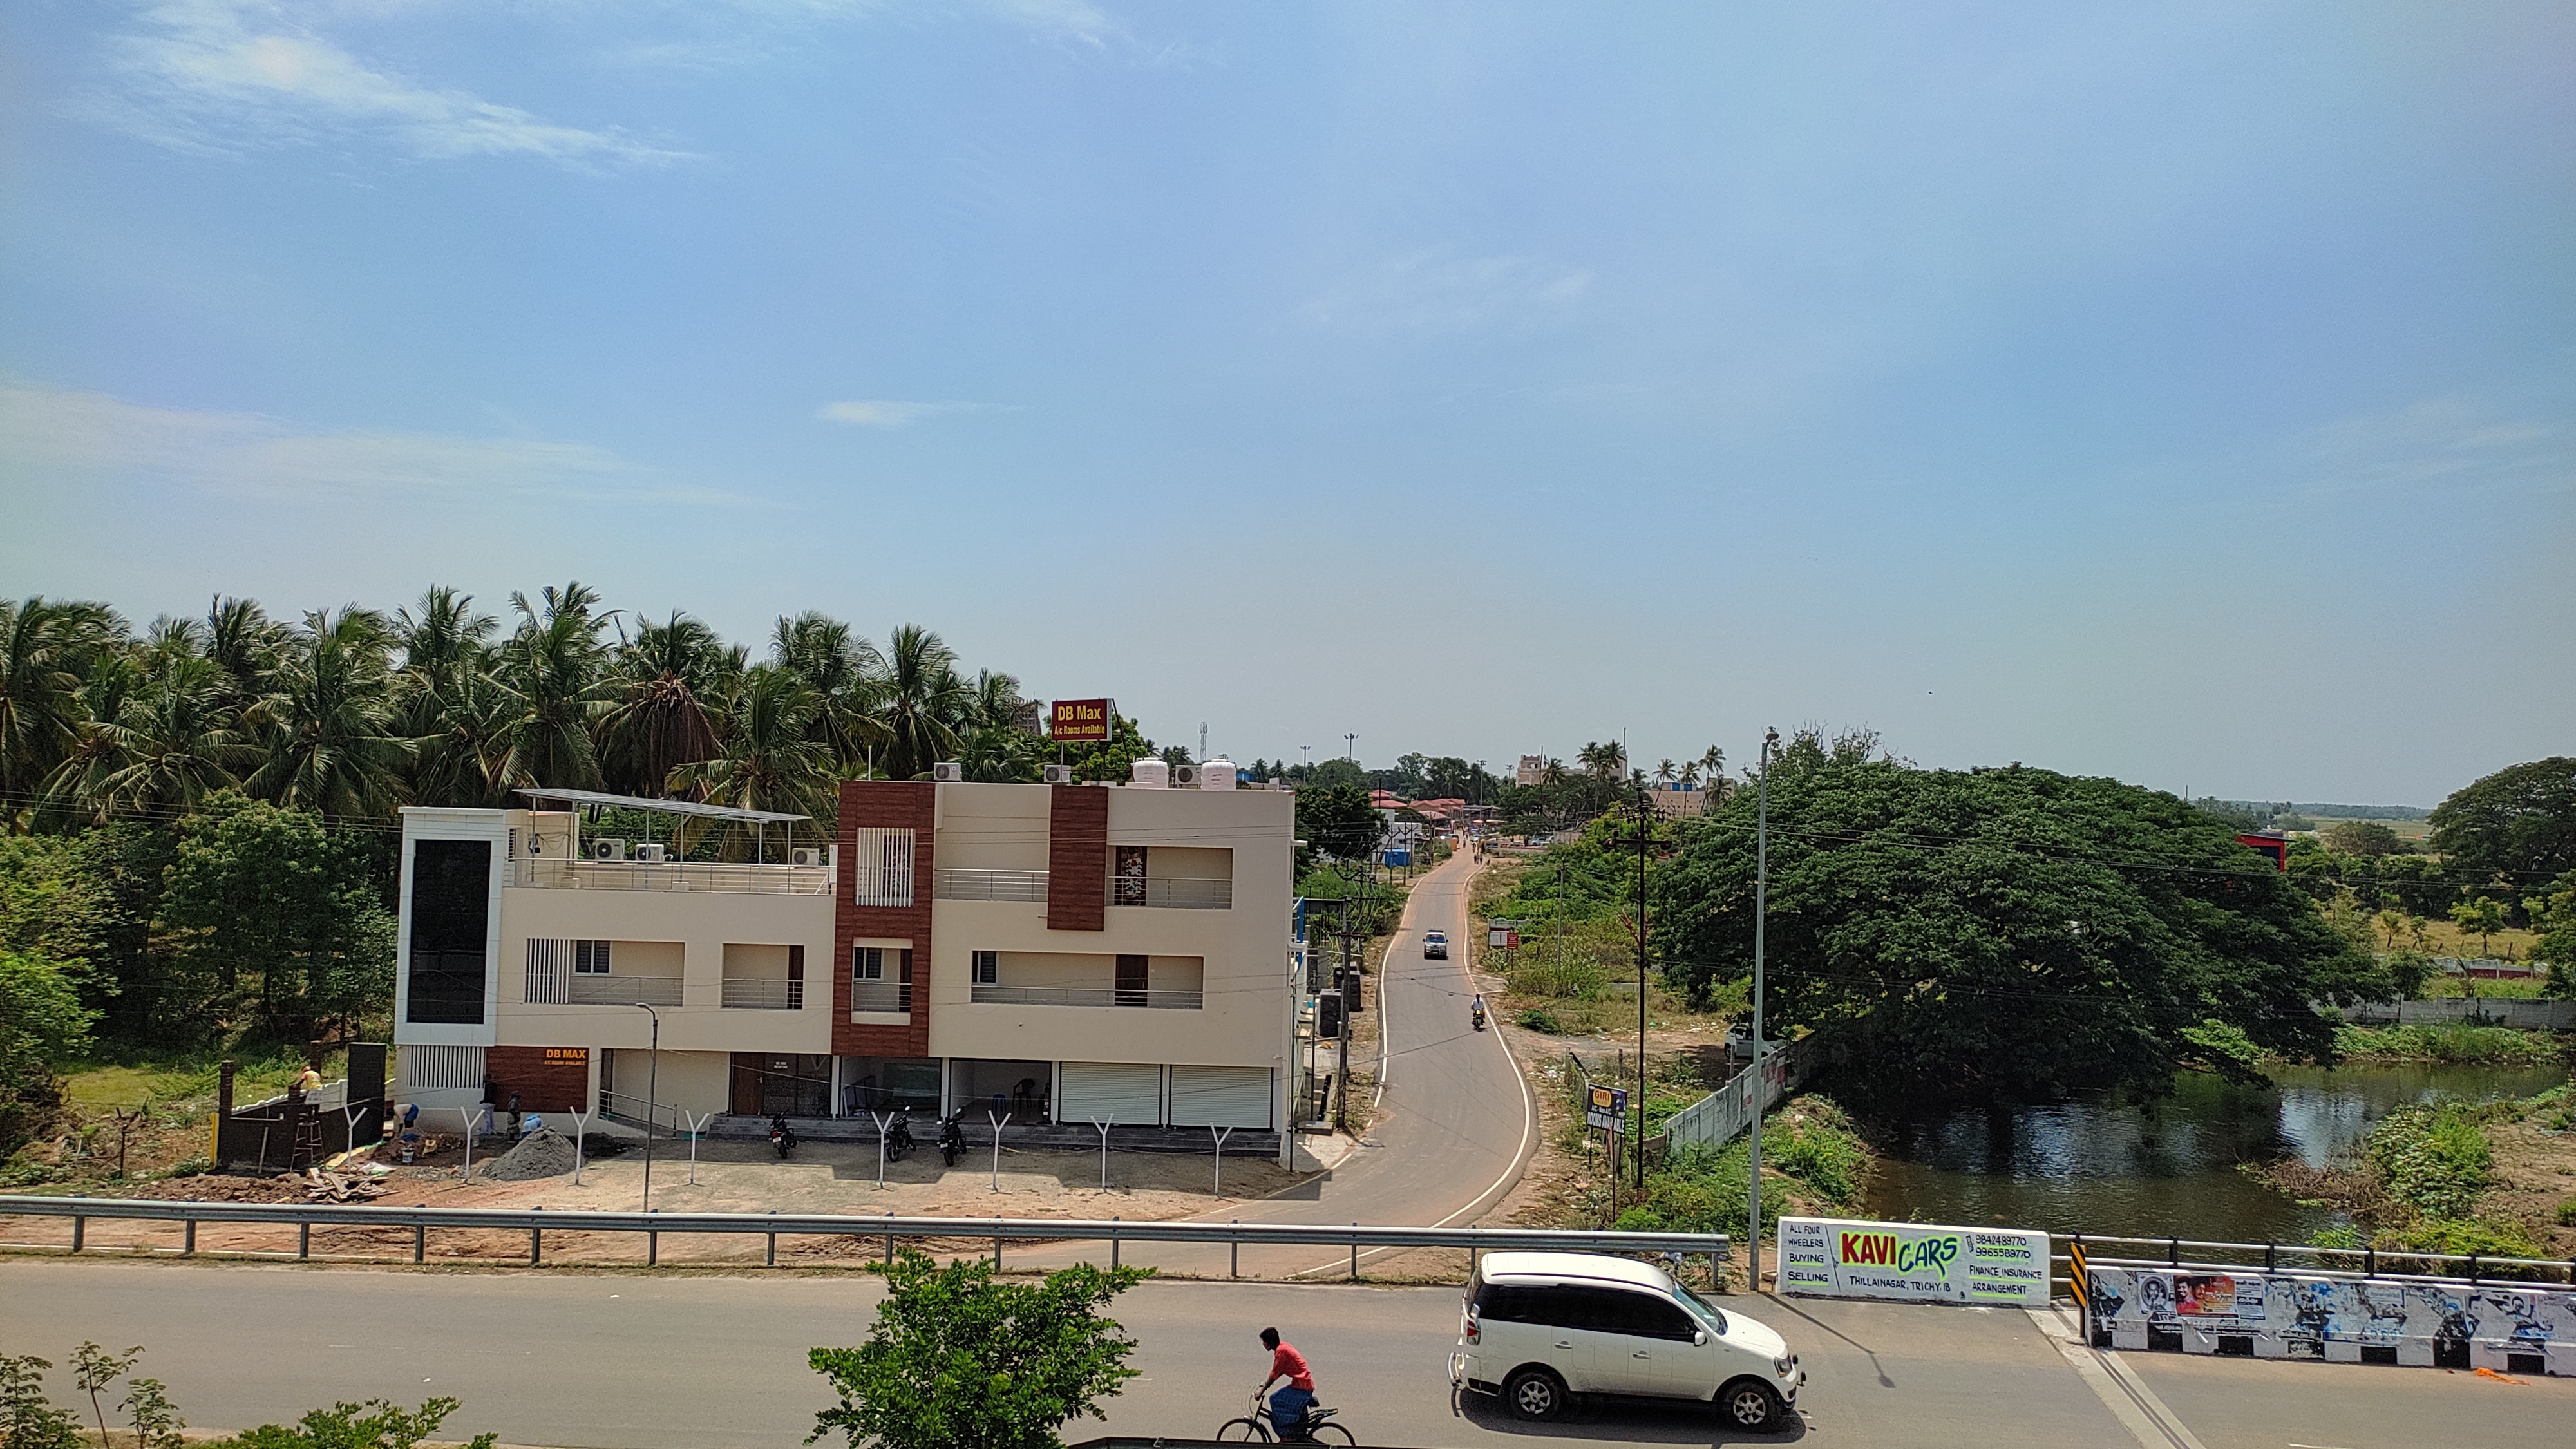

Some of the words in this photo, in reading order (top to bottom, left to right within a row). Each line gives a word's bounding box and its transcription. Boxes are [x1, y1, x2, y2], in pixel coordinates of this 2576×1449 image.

[1057, 706, 1074, 721] DB
[1077, 705, 1101, 720] Max
[1064, 725, 1081, 734] Rooms
[1081, 724, 1105, 734] Available
[546, 1049, 561, 1058] DB
[563, 1049, 586, 1058] MAX
[1595, 1090, 1610, 1101] GIRI
[1790, 1225, 1802, 1233] ALL
[1804, 1226, 1821, 1235] FOUR
[1788, 1238, 1824, 1247] WHEELERS
[1975, 1234, 2027, 1247] 9842489770
[1790, 1253, 1824, 1263] BUYING
[1842, 1233, 1897, 1265] KAVI
[1898, 1237, 1958, 1276] CARS
[1975, 1247, 2031, 1258] 9965589770
[1788, 1271, 1828, 1282] SELLING
[2002, 1268, 2043, 1279] INSURANCE
[1972, 1282, 2027, 1294] ARRANGEMENT
